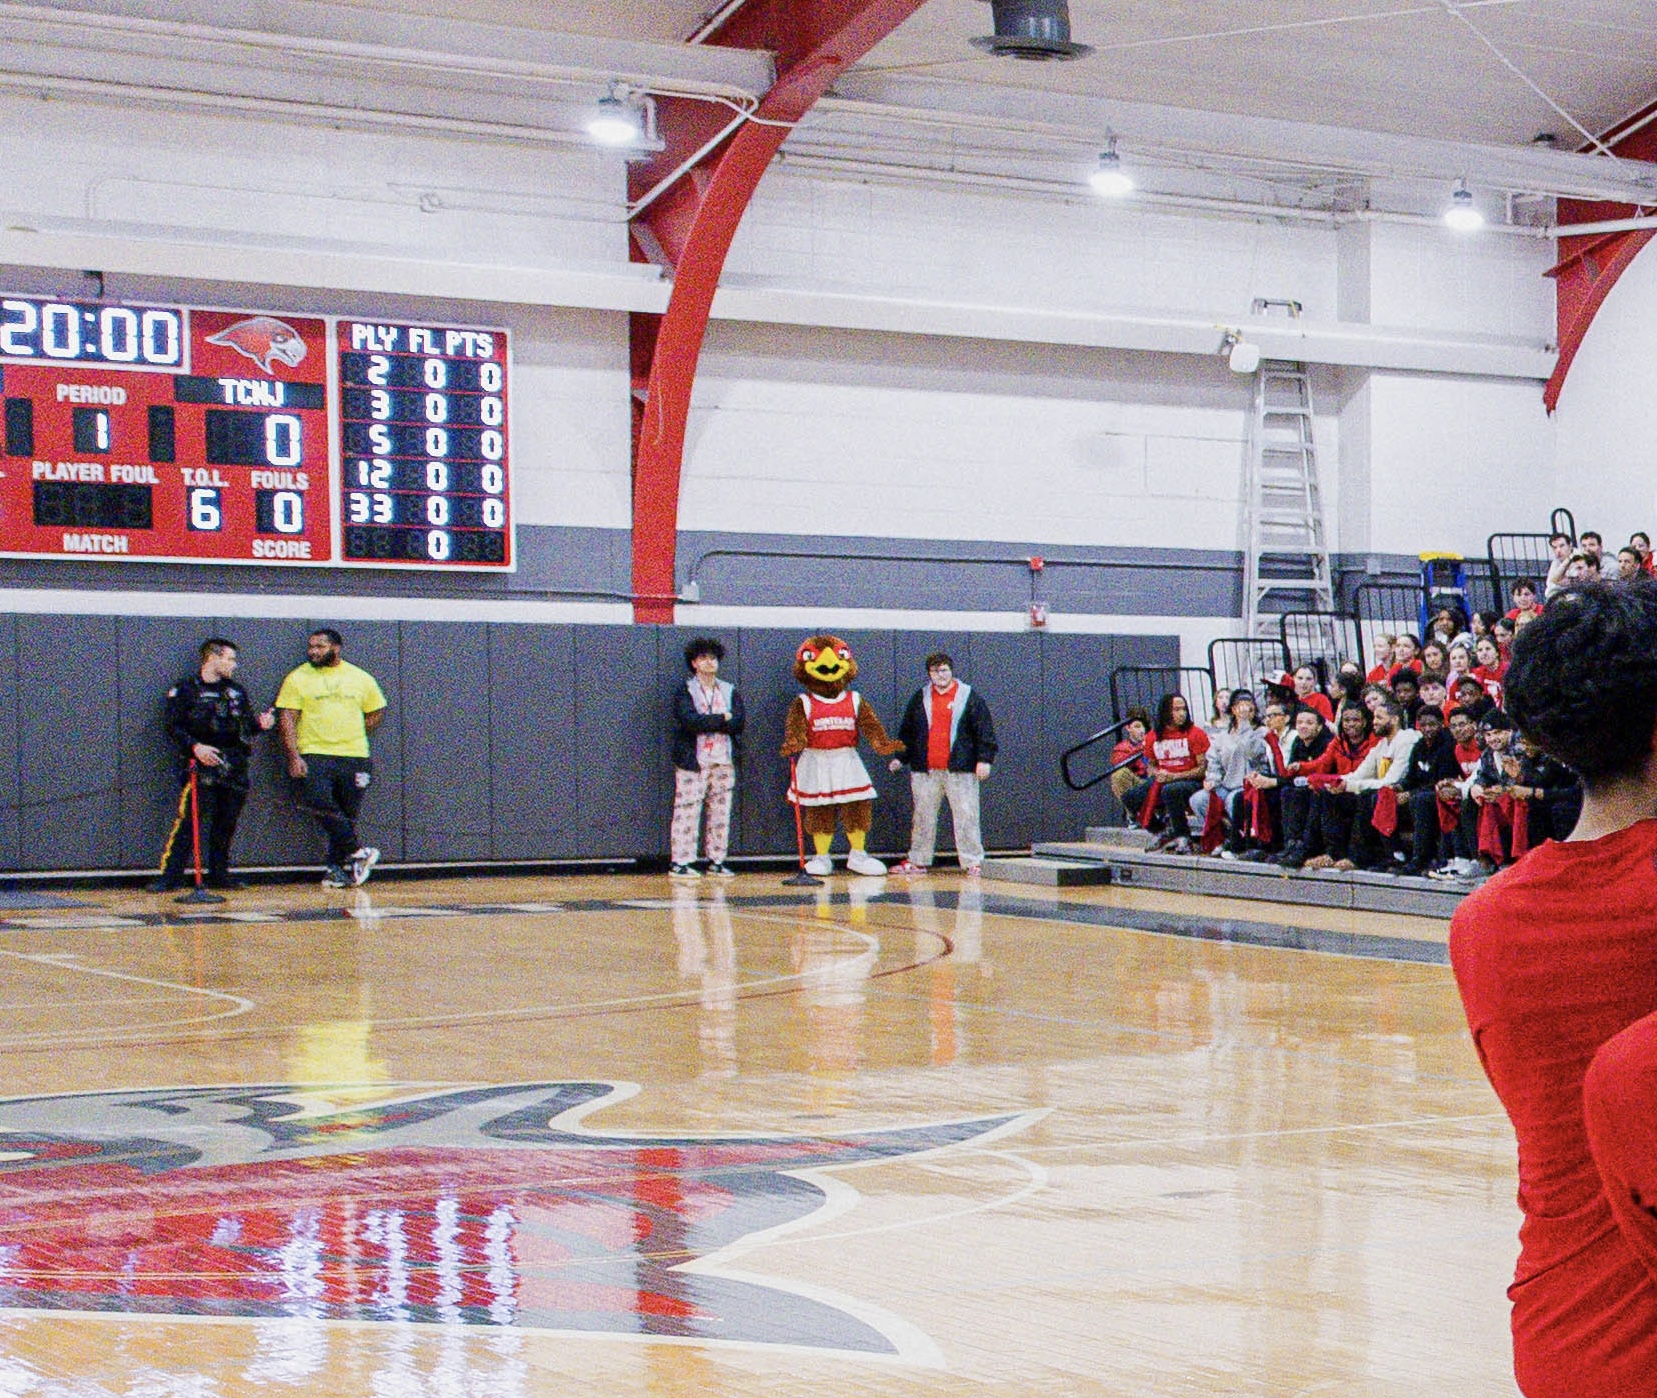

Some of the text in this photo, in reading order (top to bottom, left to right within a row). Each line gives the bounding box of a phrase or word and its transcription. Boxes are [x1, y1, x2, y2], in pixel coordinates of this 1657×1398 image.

[0, 300, 179, 364] 20:00
[352, 323, 494, 359] PLY FL PTS
[367, 355, 502, 392] 2 0 0
[56, 383, 127, 405] PERIOD
[218, 378, 284, 407] TCNJ
[370, 390, 502, 426] 3 0 0
[97, 413, 109, 449] 1
[265, 413, 302, 466] 0
[368, 424, 503, 460] 5 0 0
[32, 461, 160, 484] PLAYER FOUL
[181, 467, 230, 488] T.O.L.
[251, 470, 311, 490] FOULS
[358, 458, 503, 494] 12 0 0
[191, 488, 220, 530] 6
[273, 491, 303, 533] 0
[350, 492, 504, 528] 33 0 0
[63, 533, 129, 553] MATCH
[251, 539, 312, 559] SCORE
[427, 529, 449, 560] 0
